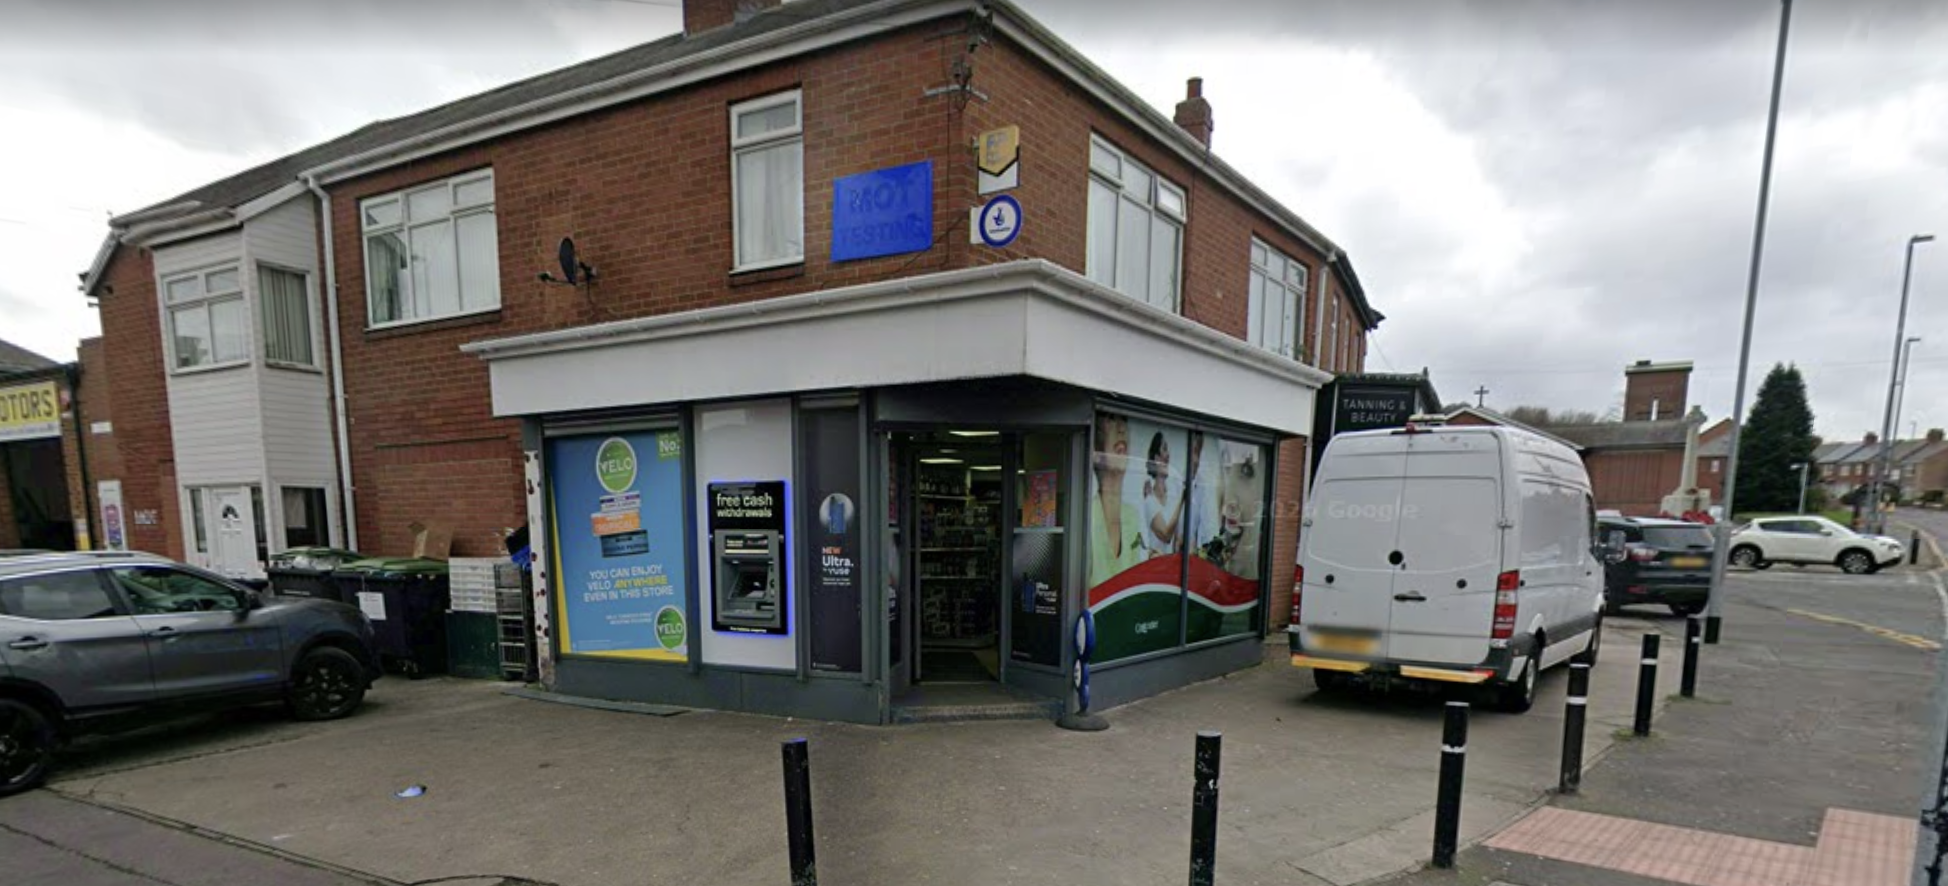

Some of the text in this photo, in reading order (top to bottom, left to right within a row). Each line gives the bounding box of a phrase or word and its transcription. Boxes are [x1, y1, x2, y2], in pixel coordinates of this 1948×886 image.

[850, 179, 916, 213] MOT
[838, 214, 926, 247] TESTING
[1342, 398, 1407, 410] TANNING &
[1350, 411, 1397, 423] BEAUTY
[599, 456, 633, 473] VELO
[717, 492, 772, 507] free cash
[717, 508, 772, 518] withdrawals
[589, 564, 663, 580] YOU CAN ENJOY
[587, 575, 668, 591] VELO ANYWHERE
[583, 585, 674, 602] EVEN IN THIS STORE
[658, 623, 683, 634] VELO
